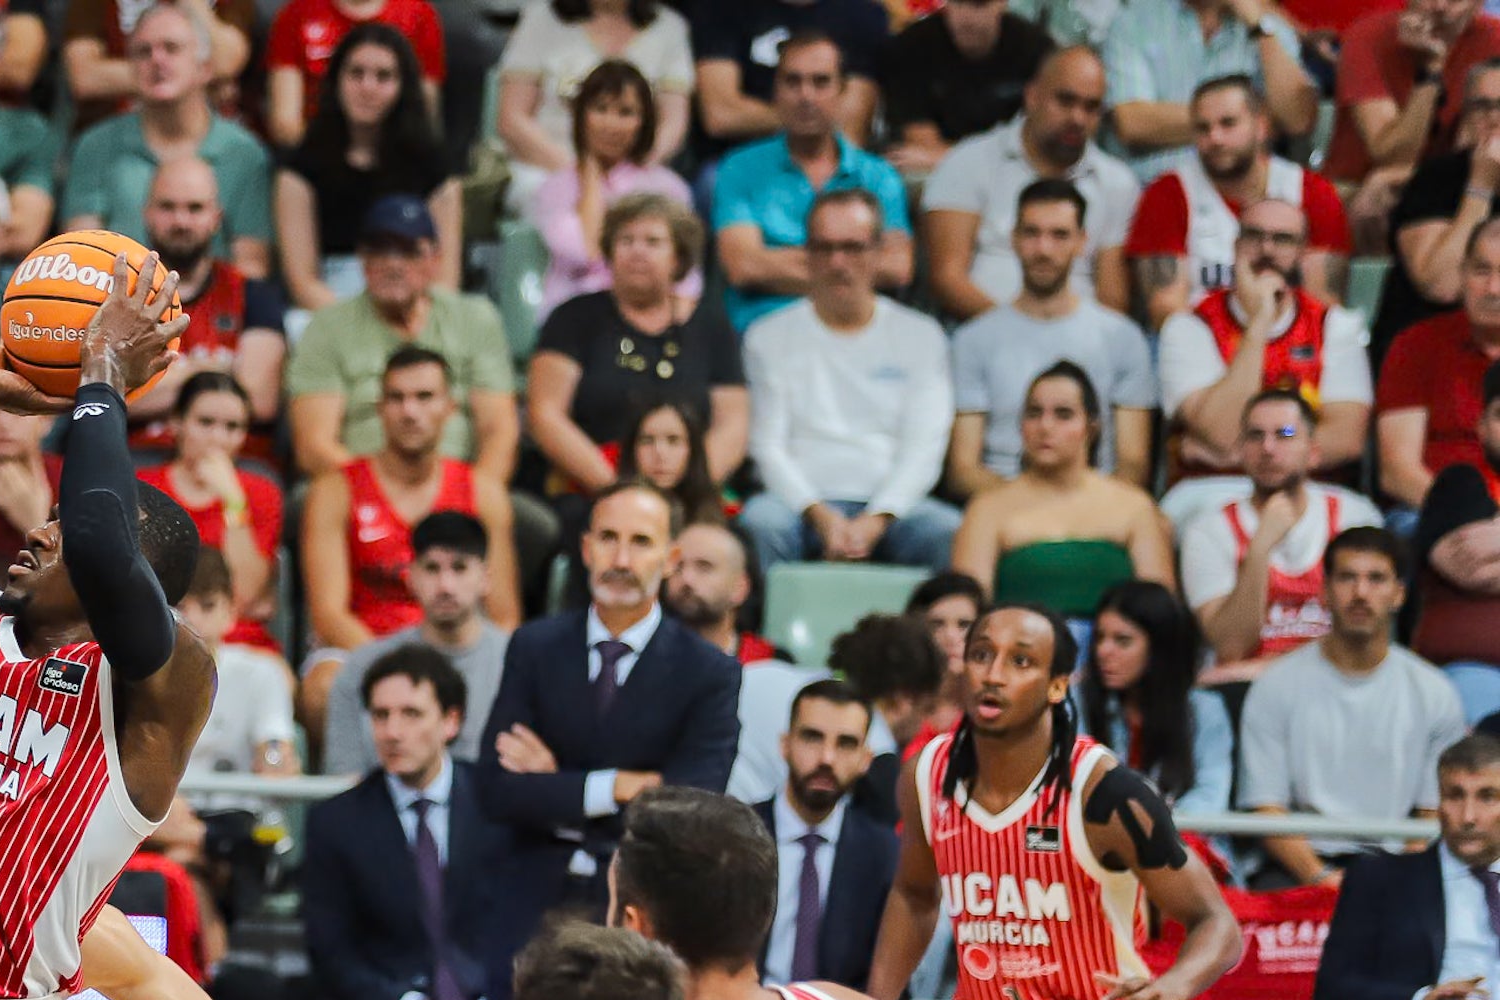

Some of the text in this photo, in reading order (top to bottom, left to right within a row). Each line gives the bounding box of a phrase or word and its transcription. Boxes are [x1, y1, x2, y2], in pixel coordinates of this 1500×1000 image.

[15, 253, 115, 294] Wilson
[32, 324, 86, 341] endes
[45, 667, 64, 678] liga
[43, 676, 80, 692] endesa
[940, 871, 1072, 922] UCAM
[956, 919, 1051, 947] MURCIA
